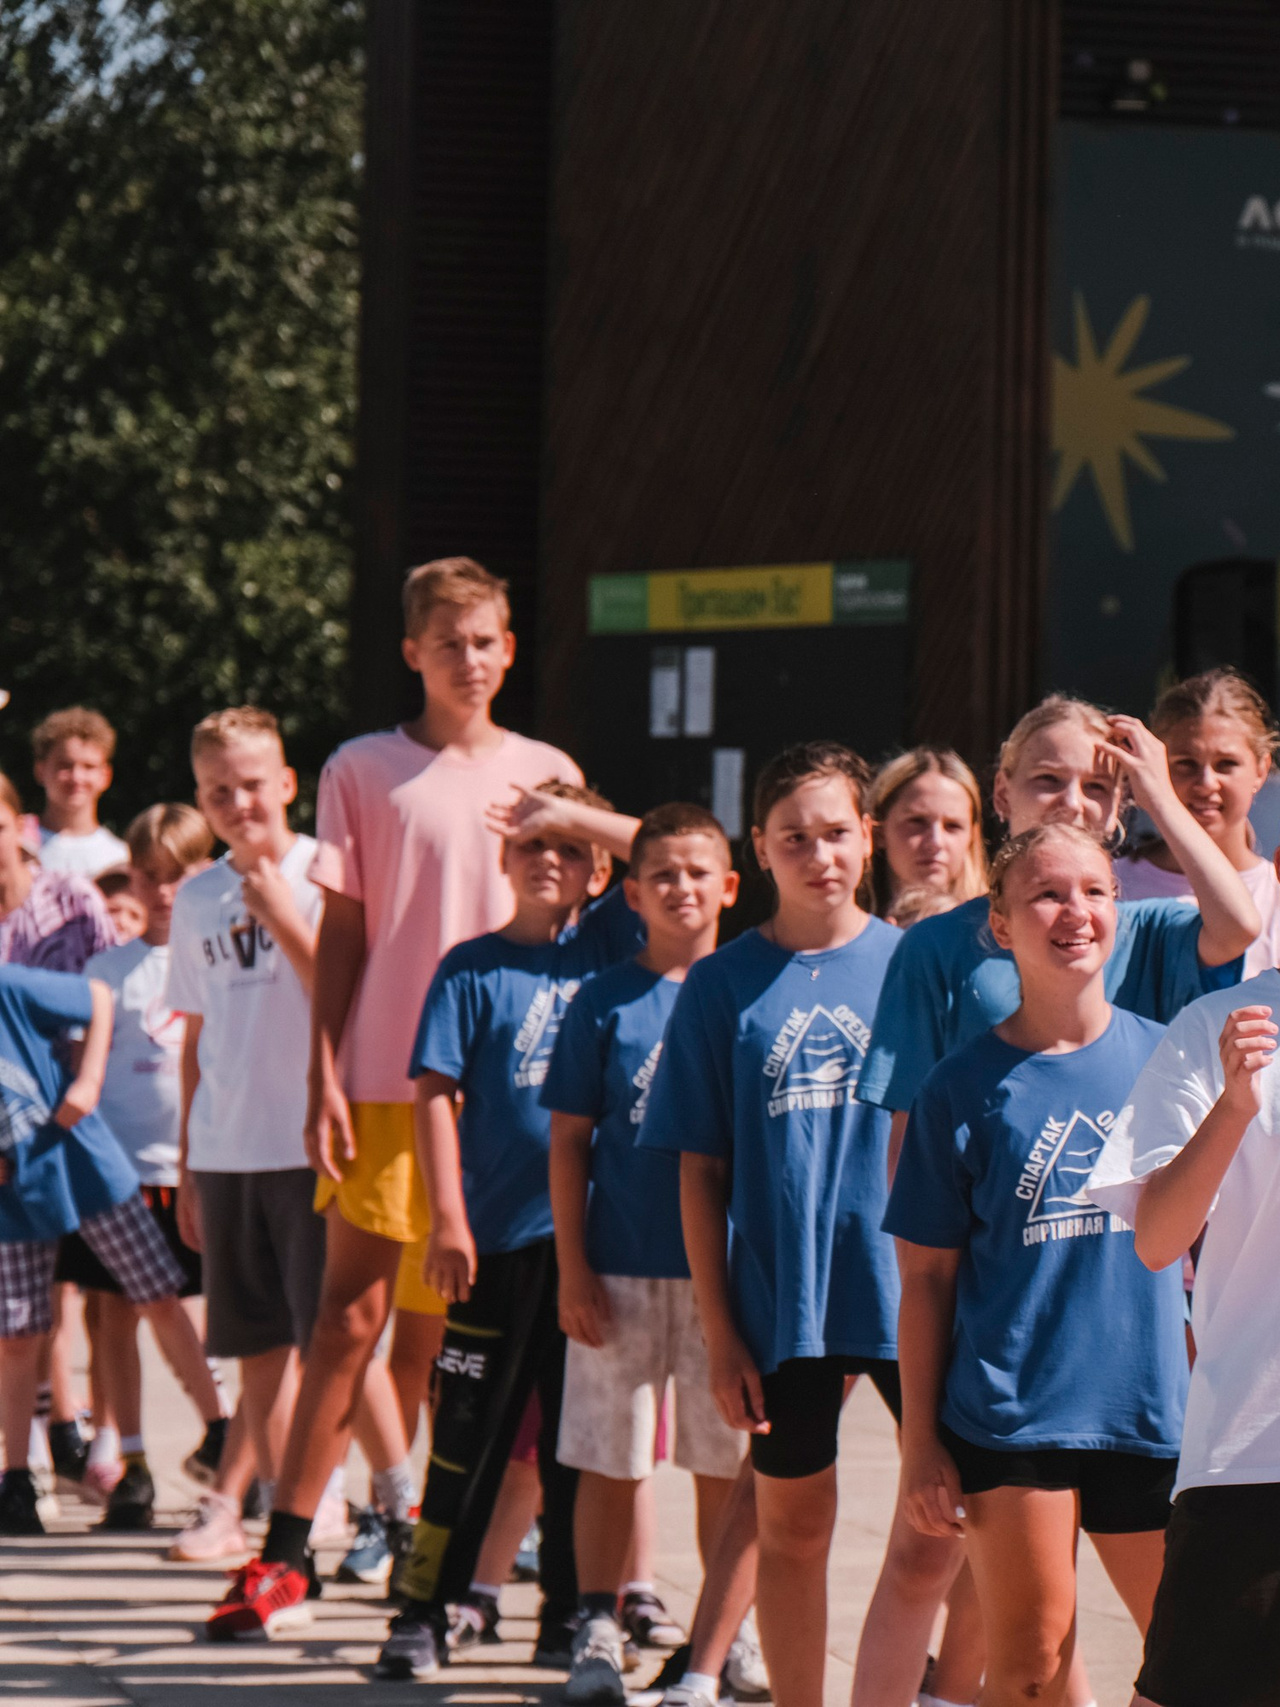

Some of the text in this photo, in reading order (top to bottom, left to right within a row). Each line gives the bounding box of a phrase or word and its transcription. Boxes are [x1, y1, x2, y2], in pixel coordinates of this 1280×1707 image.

[762, 1007, 808, 1078] СПАРТАК
[832, 1004, 872, 1049] ОРЕХ
[1015, 1115, 1067, 1200] СПАРТАК
[1023, 1215, 1104, 1247] СПОРТИВНАЯ
